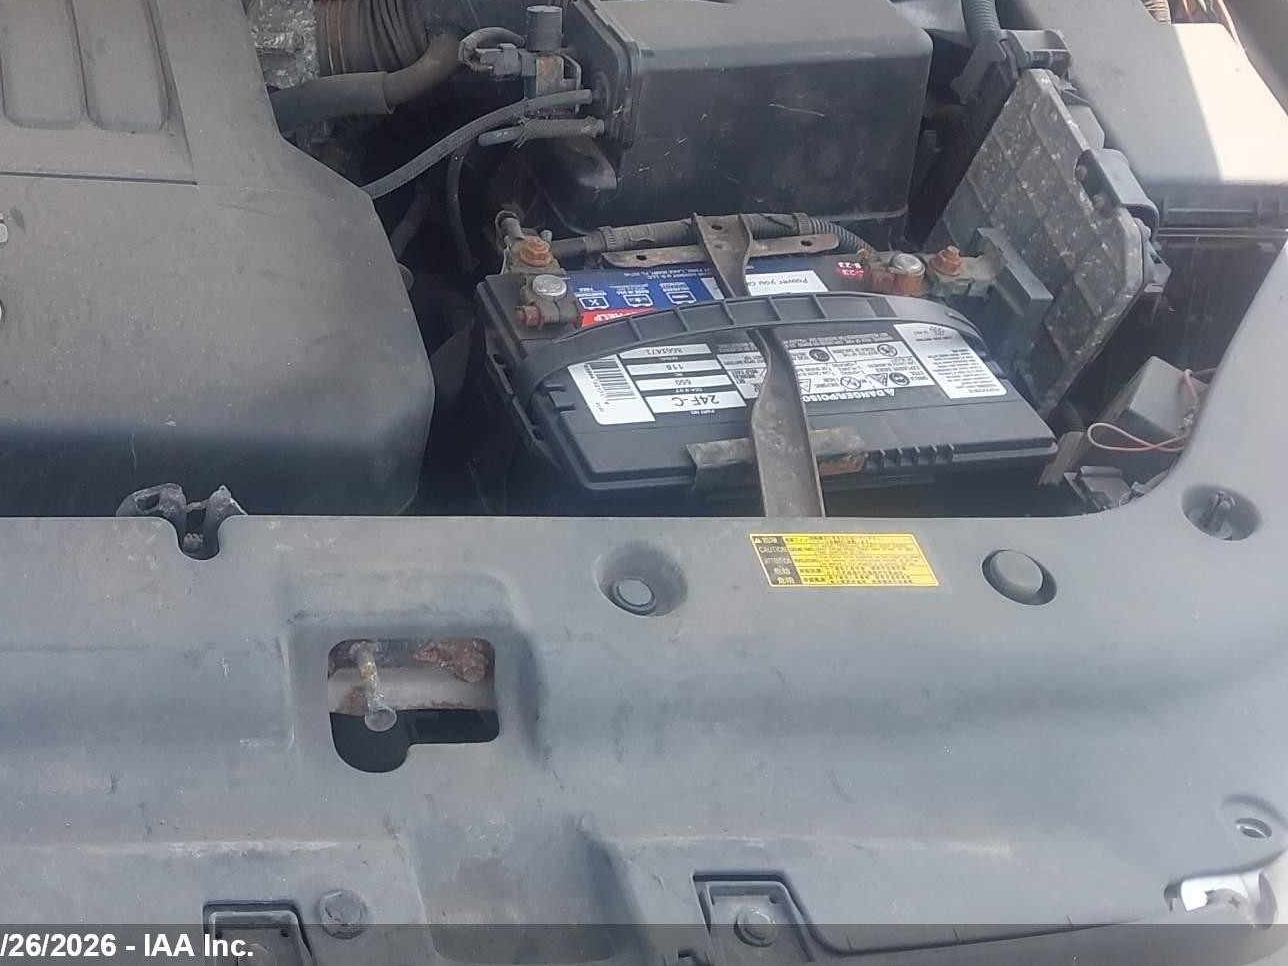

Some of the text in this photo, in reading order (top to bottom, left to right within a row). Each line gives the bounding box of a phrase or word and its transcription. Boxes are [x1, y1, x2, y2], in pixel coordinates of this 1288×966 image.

[759, 278, 777, 286] you
[671, 394, 720, 407] 24F-C
[802, 389, 883, 402] DANGER/POISO
